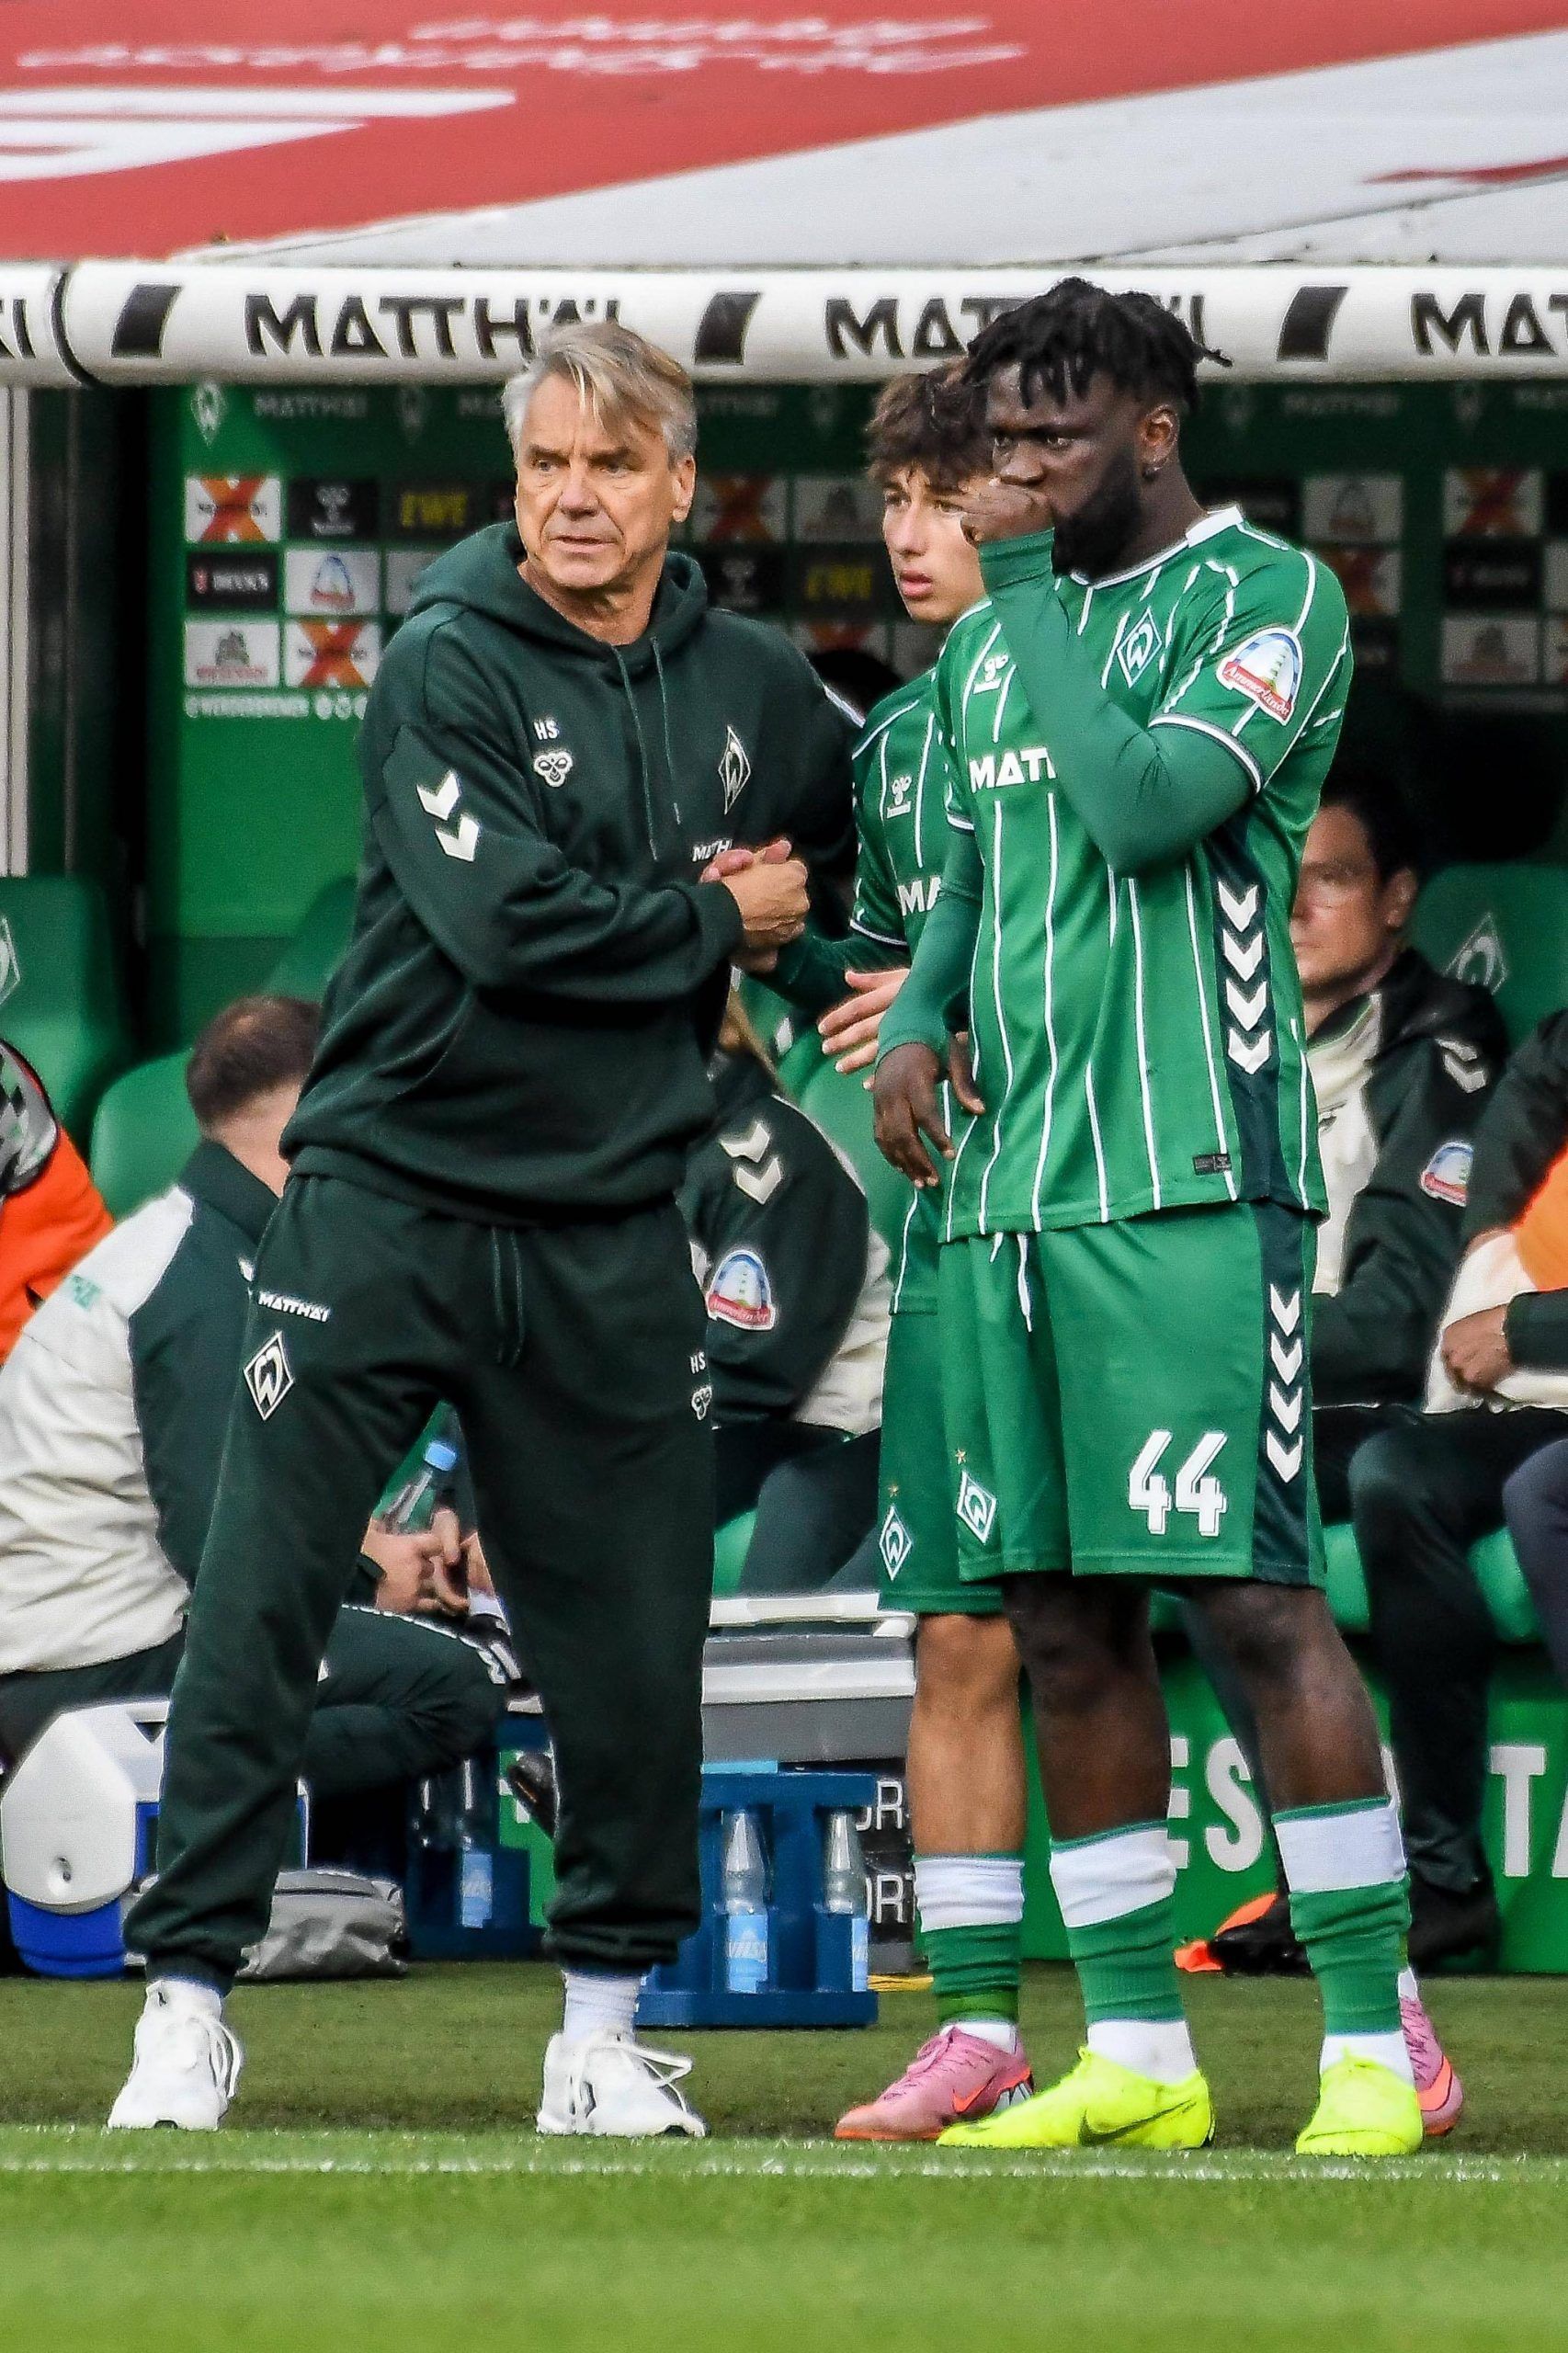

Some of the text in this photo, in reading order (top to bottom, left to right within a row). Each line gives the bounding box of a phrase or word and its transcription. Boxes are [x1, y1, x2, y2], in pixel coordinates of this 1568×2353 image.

[533, 719, 559, 740] HS
[689, 1351, 706, 1374] HS
[1129, 1429, 1228, 1537] 44
